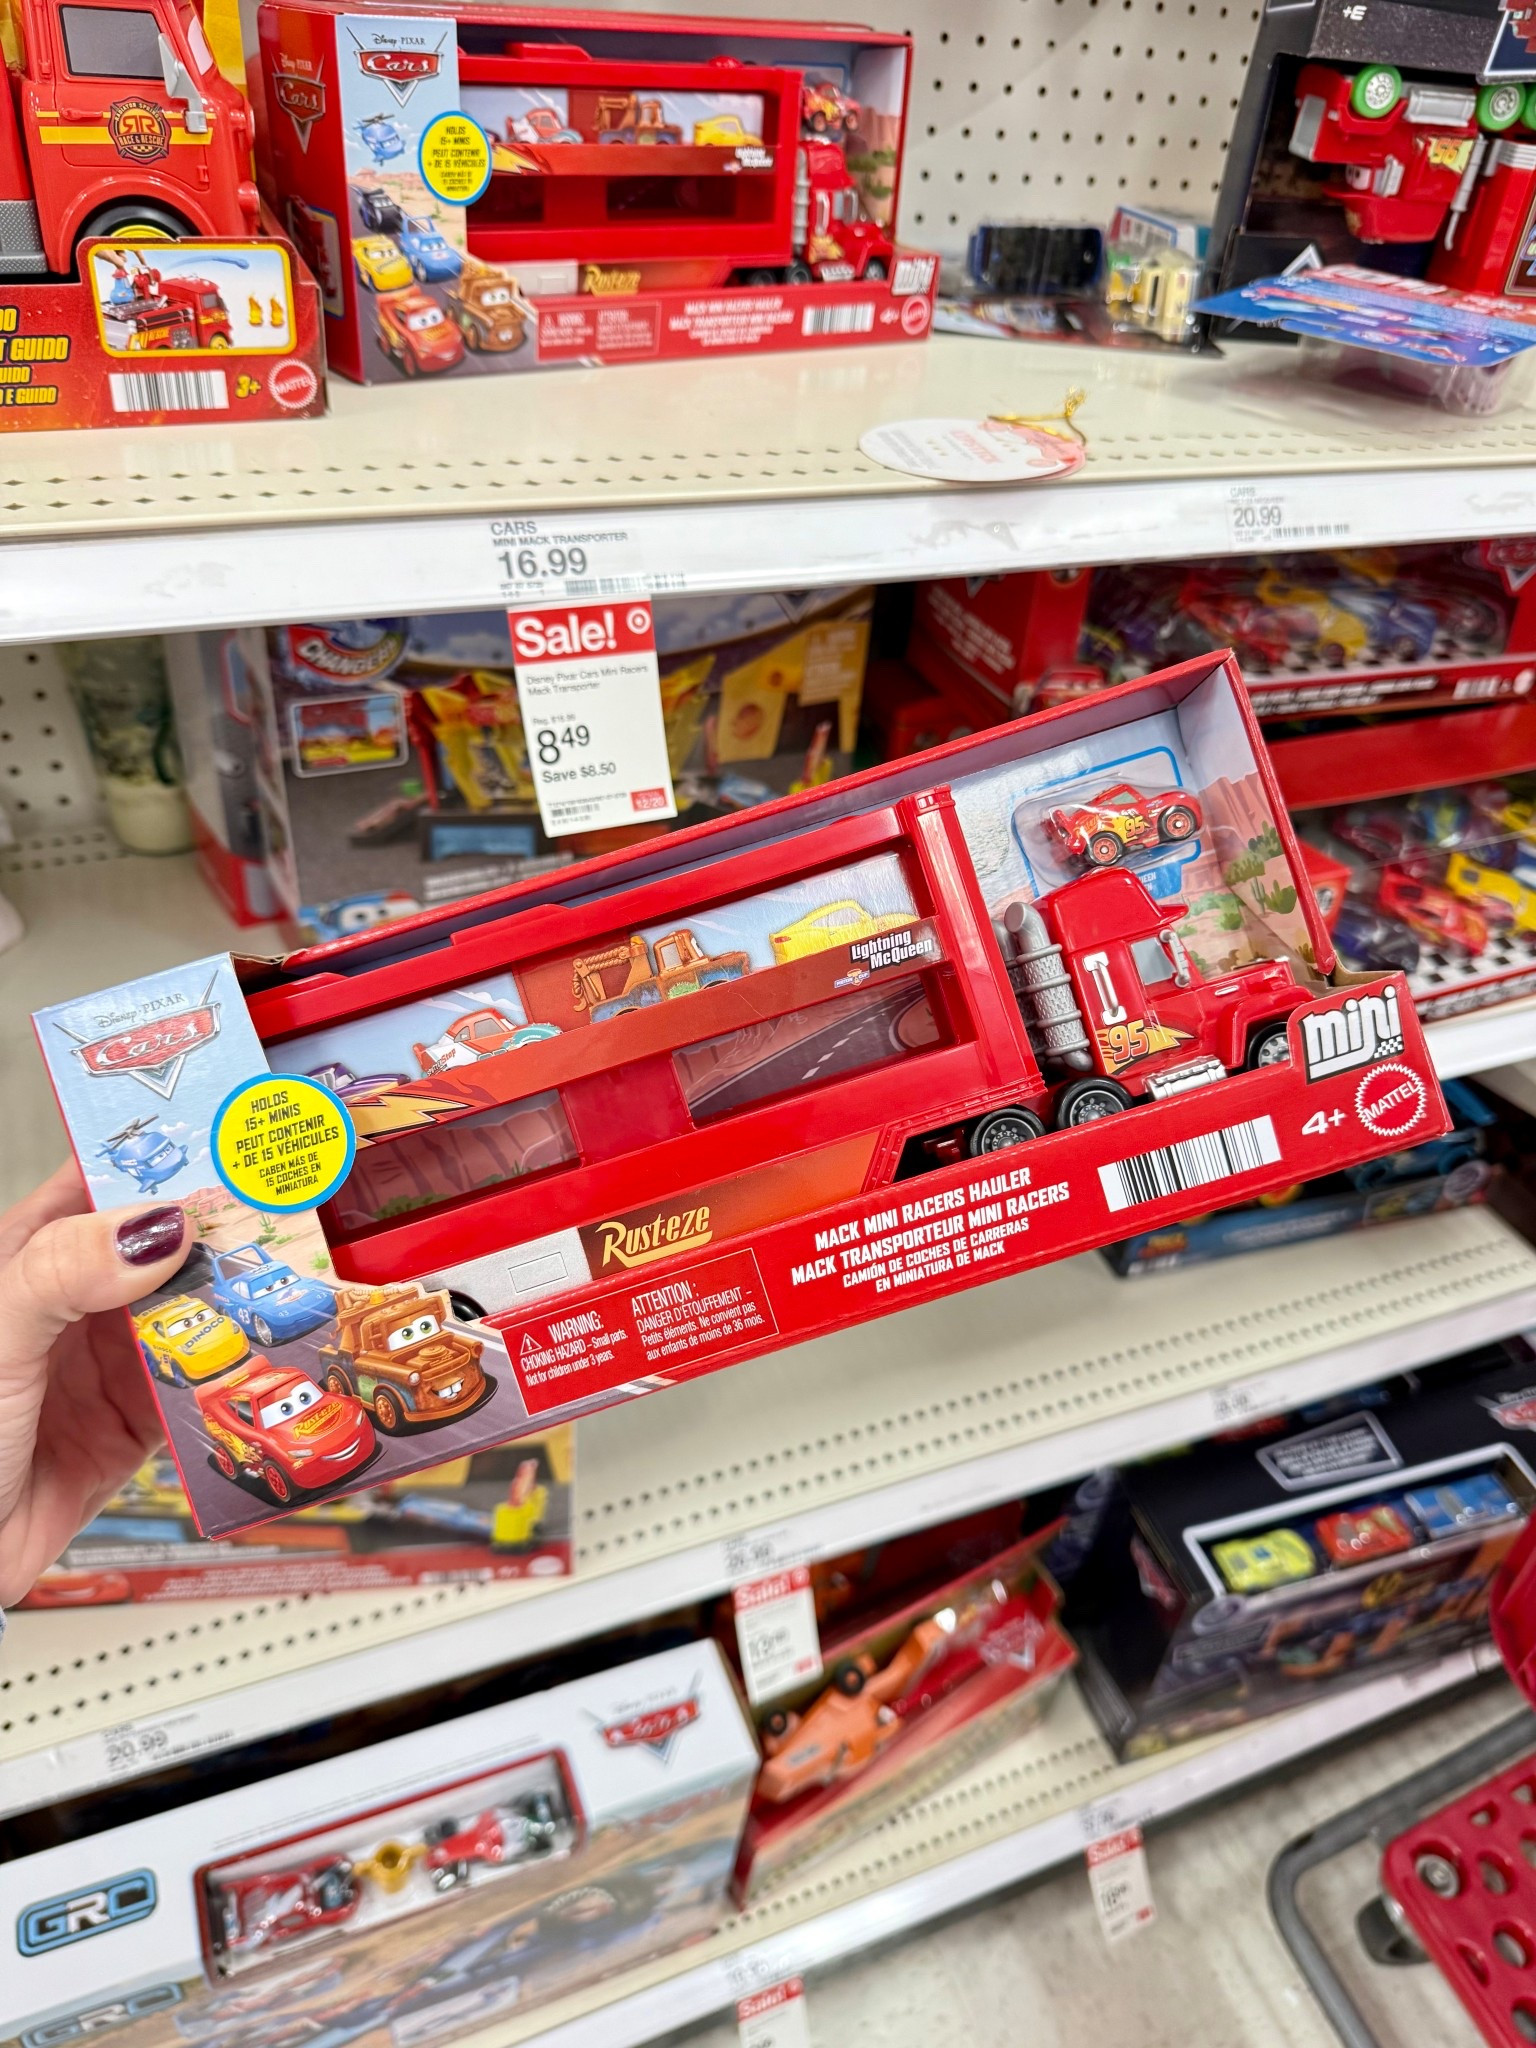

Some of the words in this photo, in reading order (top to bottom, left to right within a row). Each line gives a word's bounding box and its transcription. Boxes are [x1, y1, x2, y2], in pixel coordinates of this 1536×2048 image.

[401, 37, 425, 45] PIXAR
[367, 53, 432, 73] Cars
[10, 337, 69, 361] GUIDO
[0, 366, 30, 384] UIDO
[236, 375, 261, 398] 3+
[16, 387, 57, 404] GUIDO
[490, 521, 537, 537] CARS
[1233, 505, 1282, 528] 20.99
[493, 538, 517, 547] MINI
[519, 536, 550, 546] MACK
[553, 532, 628, 545] TRANSPORTER
[499, 547, 588, 580] 16.99
[515, 609, 617, 658] Sale!
[542, 769, 577, 784] Save
[580, 762, 617, 778] $8.50
[1124, 815, 1145, 838] 95
[850, 930, 911, 960] Lightning
[870, 939, 932, 969] McQueen
[93, 1010, 138, 1028] Disney
[143, 993, 185, 1014] PIXAR
[96, 1021, 204, 1066] Cars
[1108, 1019, 1151, 1063] 95
[1302, 985, 1402, 1079] mini
[251, 1091, 289, 1113] HOLDS
[1364, 1080, 1421, 1121] MATTEL
[245, 1117, 265, 1131] 15+
[269, 1103, 301, 1124] MINIS
[1302, 1108, 1346, 1135] 4+
[236, 1133, 265, 1154] PEUT
[268, 1114, 325, 1143] CONTENIR
[244, 1152, 259, 1168] DE
[262, 1147, 274, 1161] 15
[277, 1126, 339, 1156] VÉHICULES
[259, 1162, 286, 1178] CABEN
[288, 1155, 305, 1169] MÁS
[308, 1151, 319, 1163] DE
[266, 1178, 274, 1187] 15
[276, 1166, 308, 1184] COCHES
[311, 1162, 321, 1173] EN
[275, 1174, 318, 1196] MINIATURA
[815, 1220, 861, 1252] MACK
[864, 1208, 899, 1236] MINI
[901, 1188, 965, 1223] RACERS
[969, 1167, 1031, 1202] HAULER
[791, 1255, 837, 1286] MACK
[840, 1214, 965, 1269] TRANSPORTEUR
[968, 1202, 1002, 1230] MINI
[1006, 1181, 1070, 1217] RACERS
[842, 1262, 886, 1288] CAMIÓN
[888, 1257, 903, 1273] DE
[905, 1242, 950, 1268] COCHES
[953, 1237, 968, 1252] DE
[970, 1217, 1029, 1246] CARRERAS
[876, 1278, 891, 1293] EN
[893, 1257, 954, 1287] MINIATURA
[956, 1252, 971, 1267] DE
[973, 1240, 1005, 1262] MACK
[631, 1280, 693, 1317] ATTENTION
[636, 1309, 674, 1333] DANGER
[674, 1287, 742, 1321] D'ÉTOUFFEMENT
[238, 1307, 251, 1324] 43
[548, 1310, 604, 1343] WARNING:
[641, 1331, 663, 1347] Petits
[664, 1320, 699, 1340] éléments.
[699, 1315, 710, 1328] Ne
[711, 1304, 742, 1324] convient
[742, 1301, 756, 1317] pas
[184, 1317, 225, 1349] DINOCO
[646, 1349, 661, 1360] aux
[661, 1339, 688, 1355] enfants
[688, 1334, 699, 1347] de
[699, 1327, 722, 1343] moins
[722, 1324, 733, 1335] de
[732, 1318, 744, 1332] 36
[744, 1313, 765, 1328] mois.
[520, 1348, 556, 1372] CHOKING
[554, 1339, 587, 1360] HAZARD
[592, 1333, 610, 1349] Small
[610, 1329, 628, 1345] parts.
[525, 1373, 538, 1387] Not
[538, 1370, 547, 1382] for
[548, 1363, 572, 1380] children
[571, 1356, 590, 1373] under
[590, 1354, 596, 1366] 3
[595, 1350, 615, 1366] years.
[27, 1879, 148, 1946] GRC
